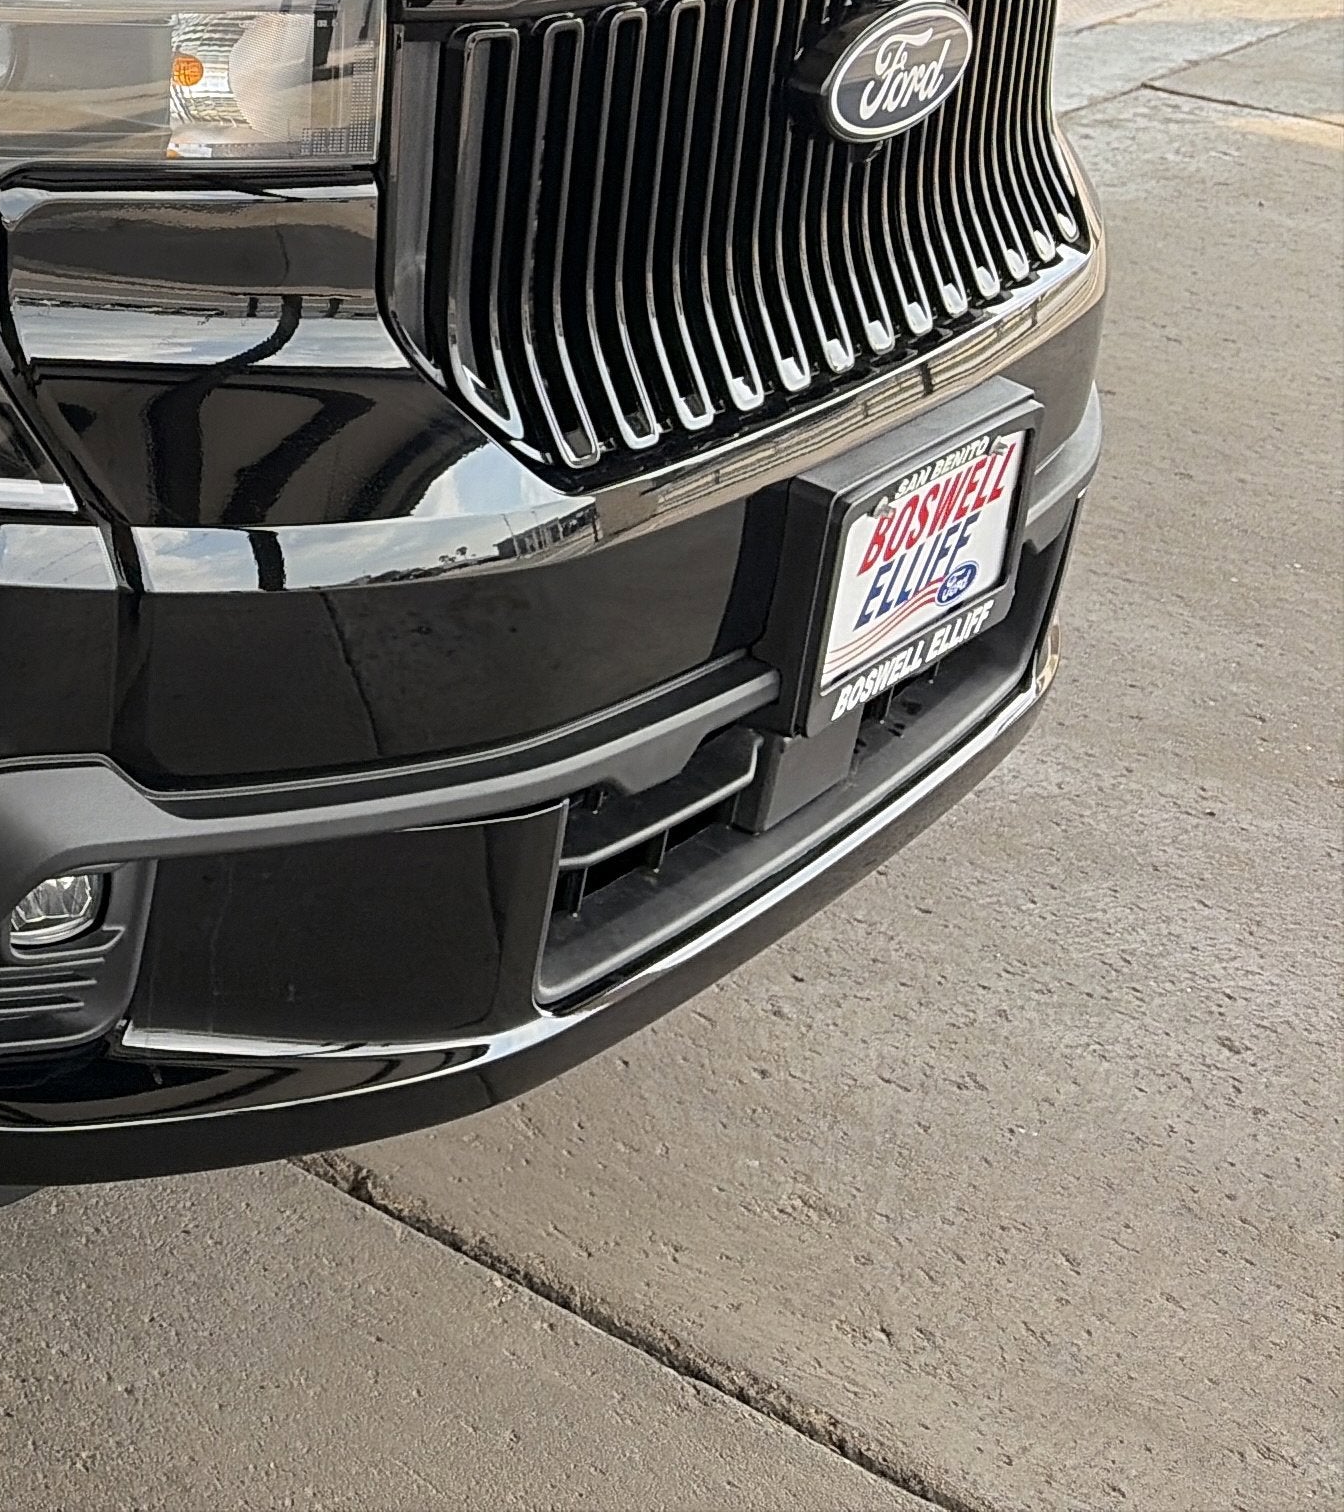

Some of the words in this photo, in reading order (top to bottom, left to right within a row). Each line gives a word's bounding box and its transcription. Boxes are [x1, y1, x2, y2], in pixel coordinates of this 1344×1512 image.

[859, 28, 951, 121] Ford
[857, 442, 1017, 577] BOSWELL
[894, 465, 933, 500] SAN
[930, 435, 990, 481] BENITO
[852, 510, 982, 632] ELLIFF
[941, 567, 972, 602] Ford
[831, 640, 925, 722] BOSWELL
[925, 599, 995, 663] ELLIFF
